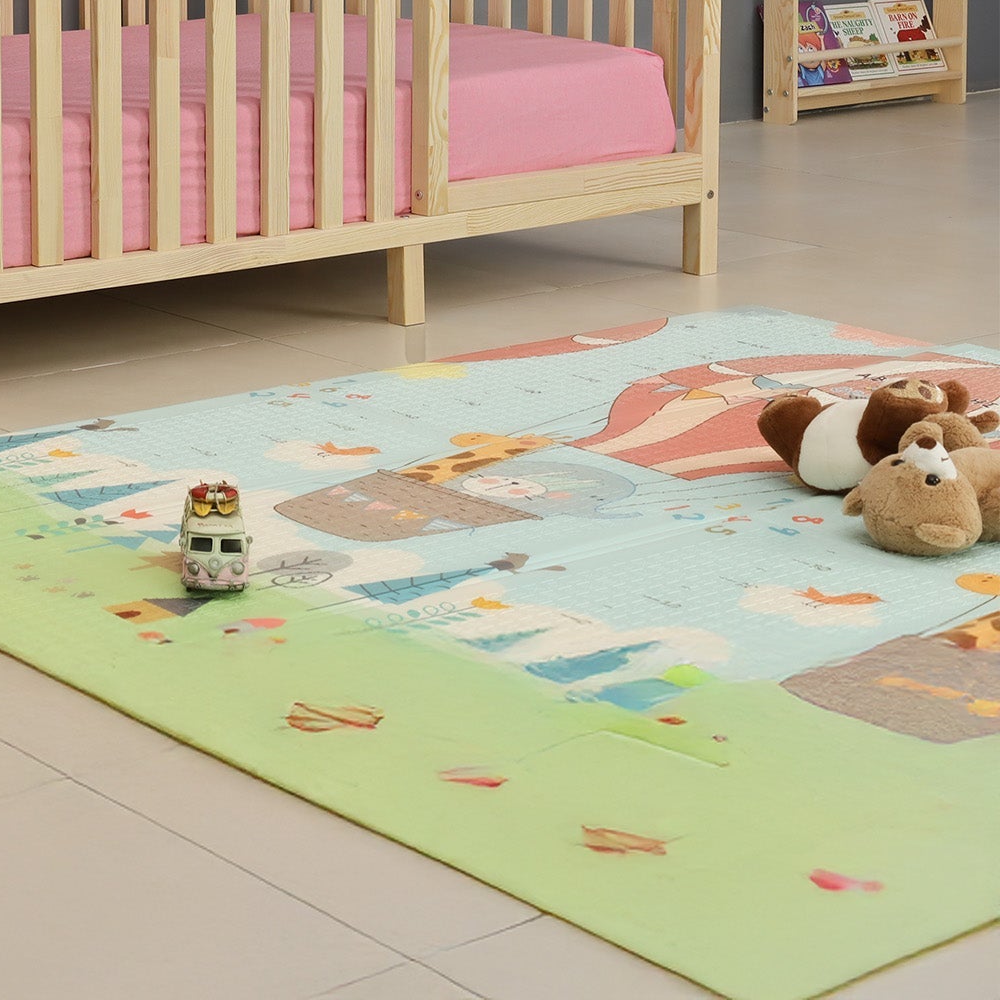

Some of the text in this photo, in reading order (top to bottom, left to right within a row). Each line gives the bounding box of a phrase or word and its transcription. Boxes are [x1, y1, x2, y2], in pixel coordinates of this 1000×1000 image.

[888, 12, 918, 22] BARN ON
[842, 18, 873, 29] NAUGHTY
[897, 21, 915, 29] FIRE
[842, 27, 864, 36] SHEEP
